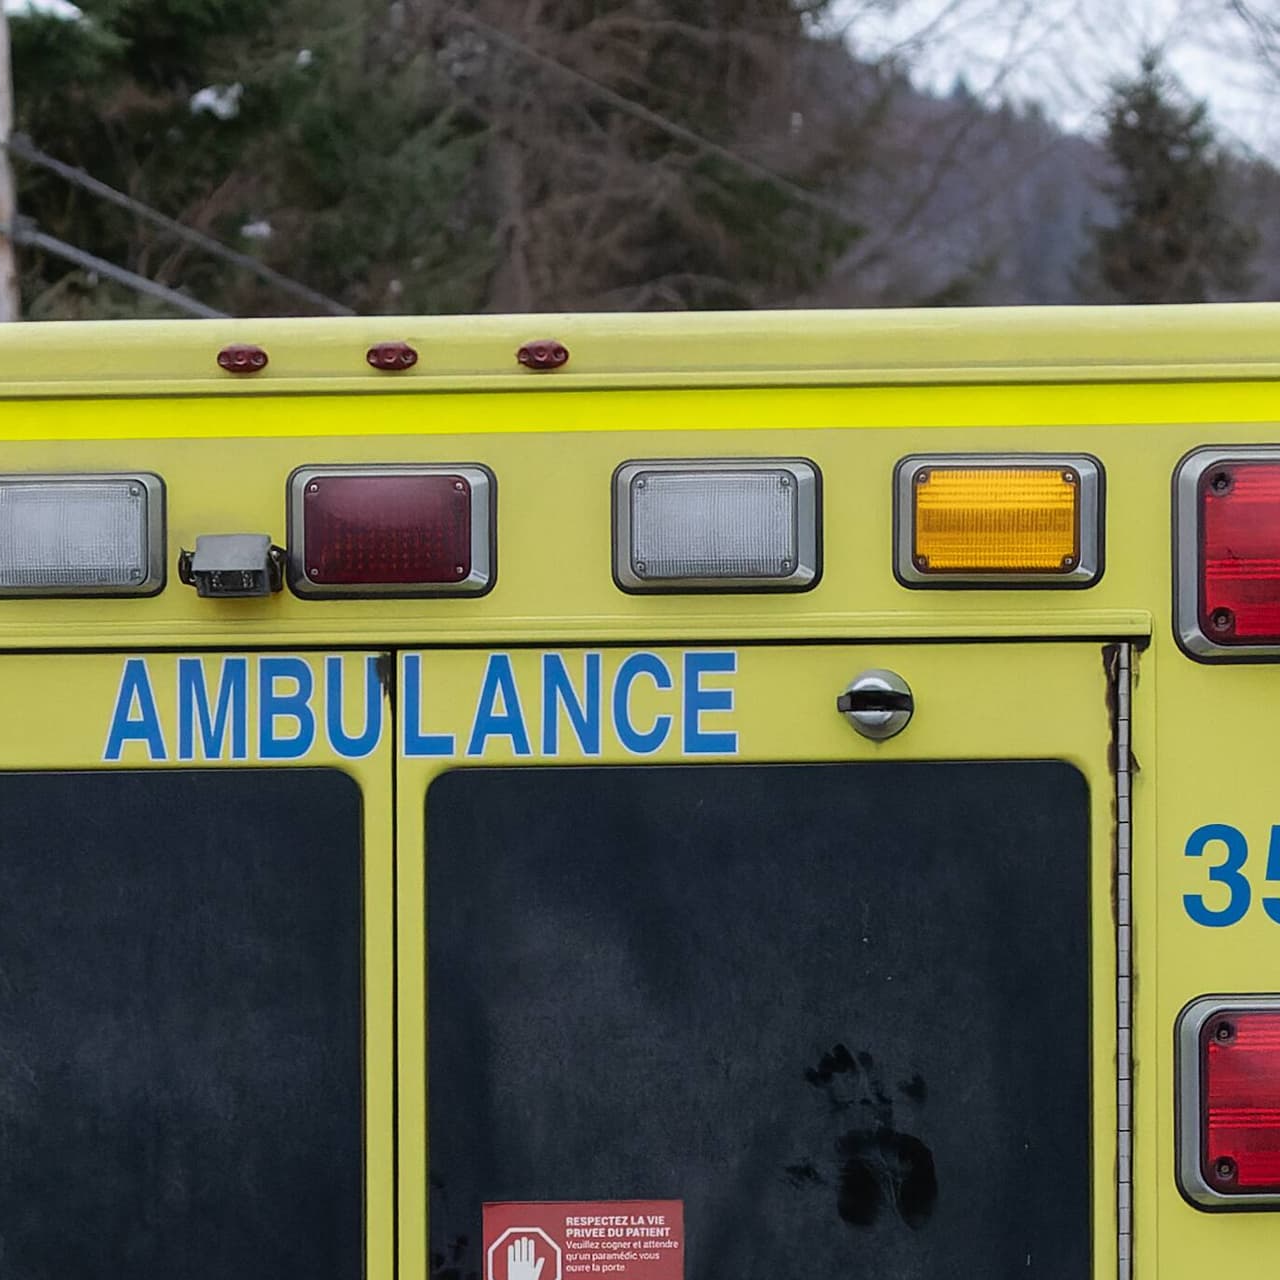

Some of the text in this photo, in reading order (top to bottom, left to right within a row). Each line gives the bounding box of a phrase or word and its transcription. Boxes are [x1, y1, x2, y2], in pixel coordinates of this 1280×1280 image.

[102, 650, 739, 762] AMBULANCE
[566, 1216, 665, 1225] RESPECTEZ LA VIE
[608, 1228, 624, 1237] DU
[626, 1228, 671, 1237] PATIENT
[566, 1240, 679, 1250] Veuillez cogner et attendre
[639, 1252, 660, 1260] vous
[592, 1263, 601, 1272] la
[602, 1264, 625, 1273] porte
